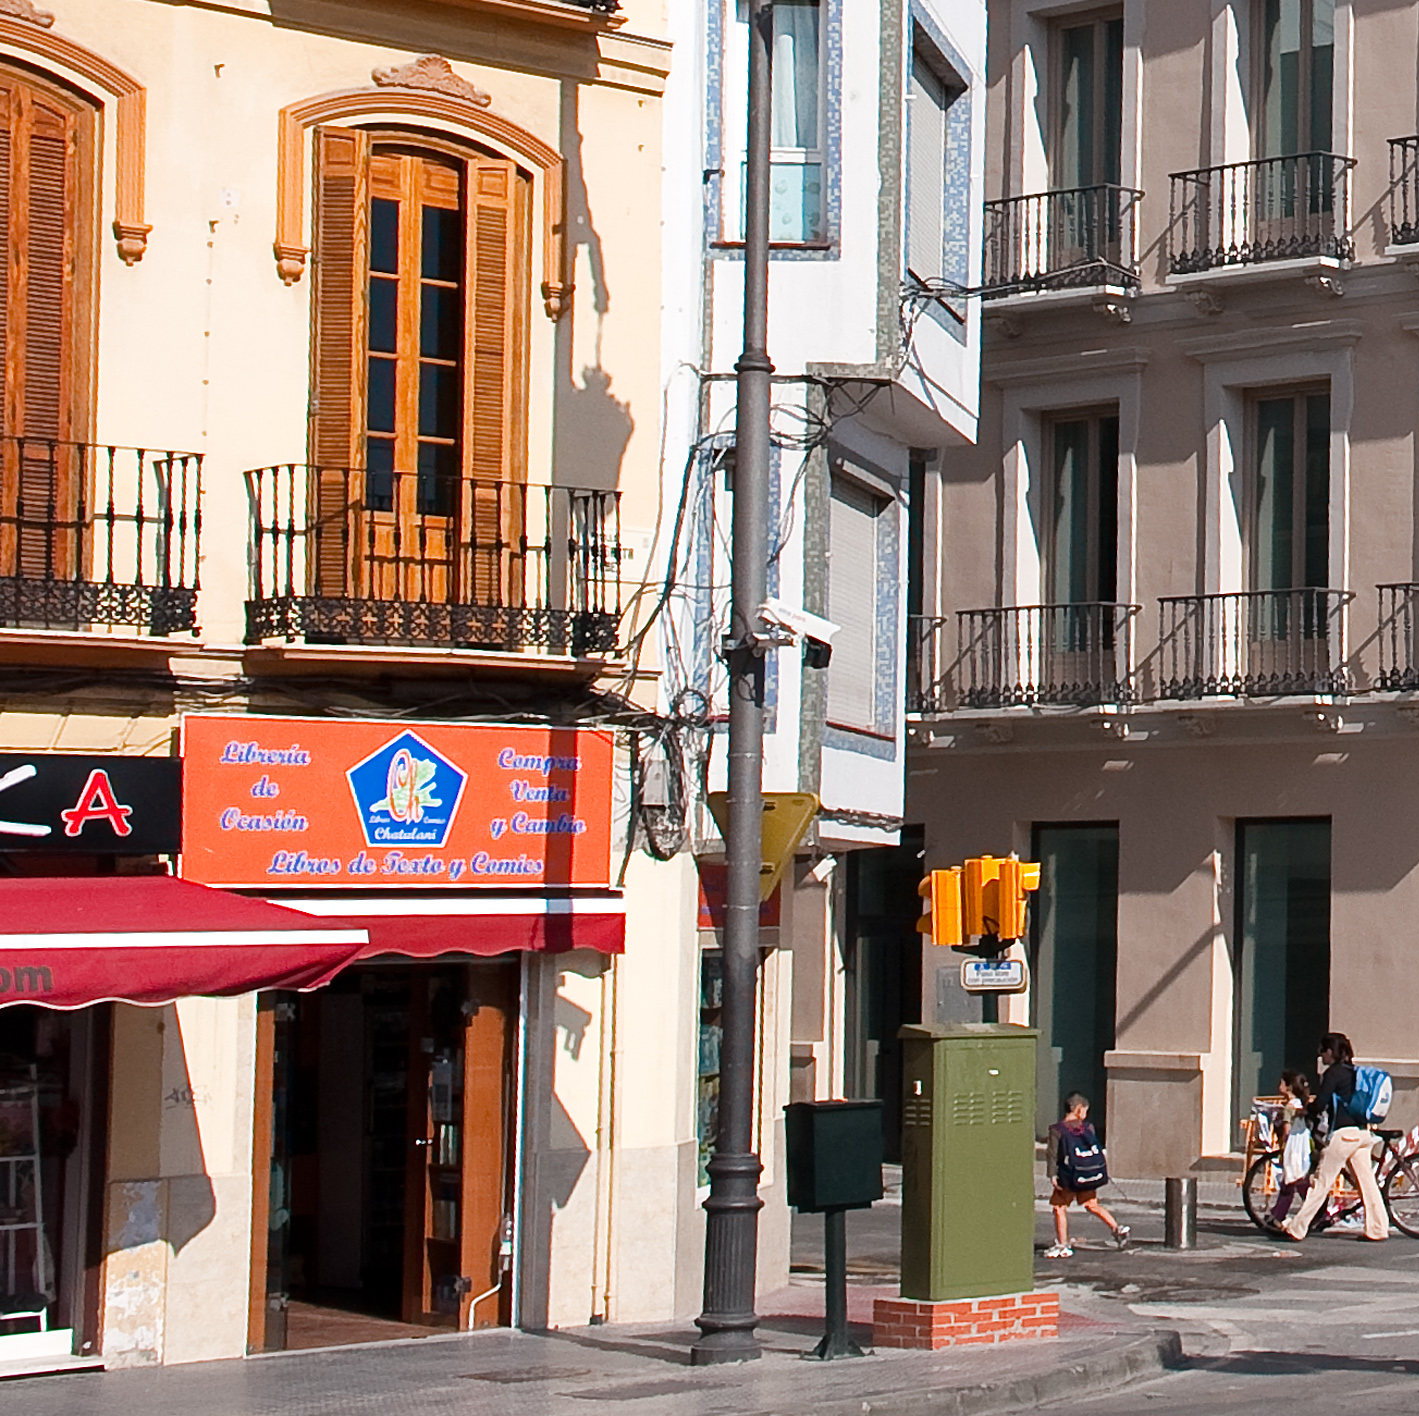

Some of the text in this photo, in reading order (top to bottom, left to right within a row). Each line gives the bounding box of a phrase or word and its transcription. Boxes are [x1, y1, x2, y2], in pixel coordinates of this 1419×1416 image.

[220, 741, 311, 766] Librería
[498, 747, 582, 777] Compra
[251, 774, 280, 798] de
[510, 779, 570, 803] Venta
[220, 807, 309, 832] Ocasión
[490, 811, 587, 840] y Cambio
[266, 850, 544, 881] Libros de Texto y Comics
